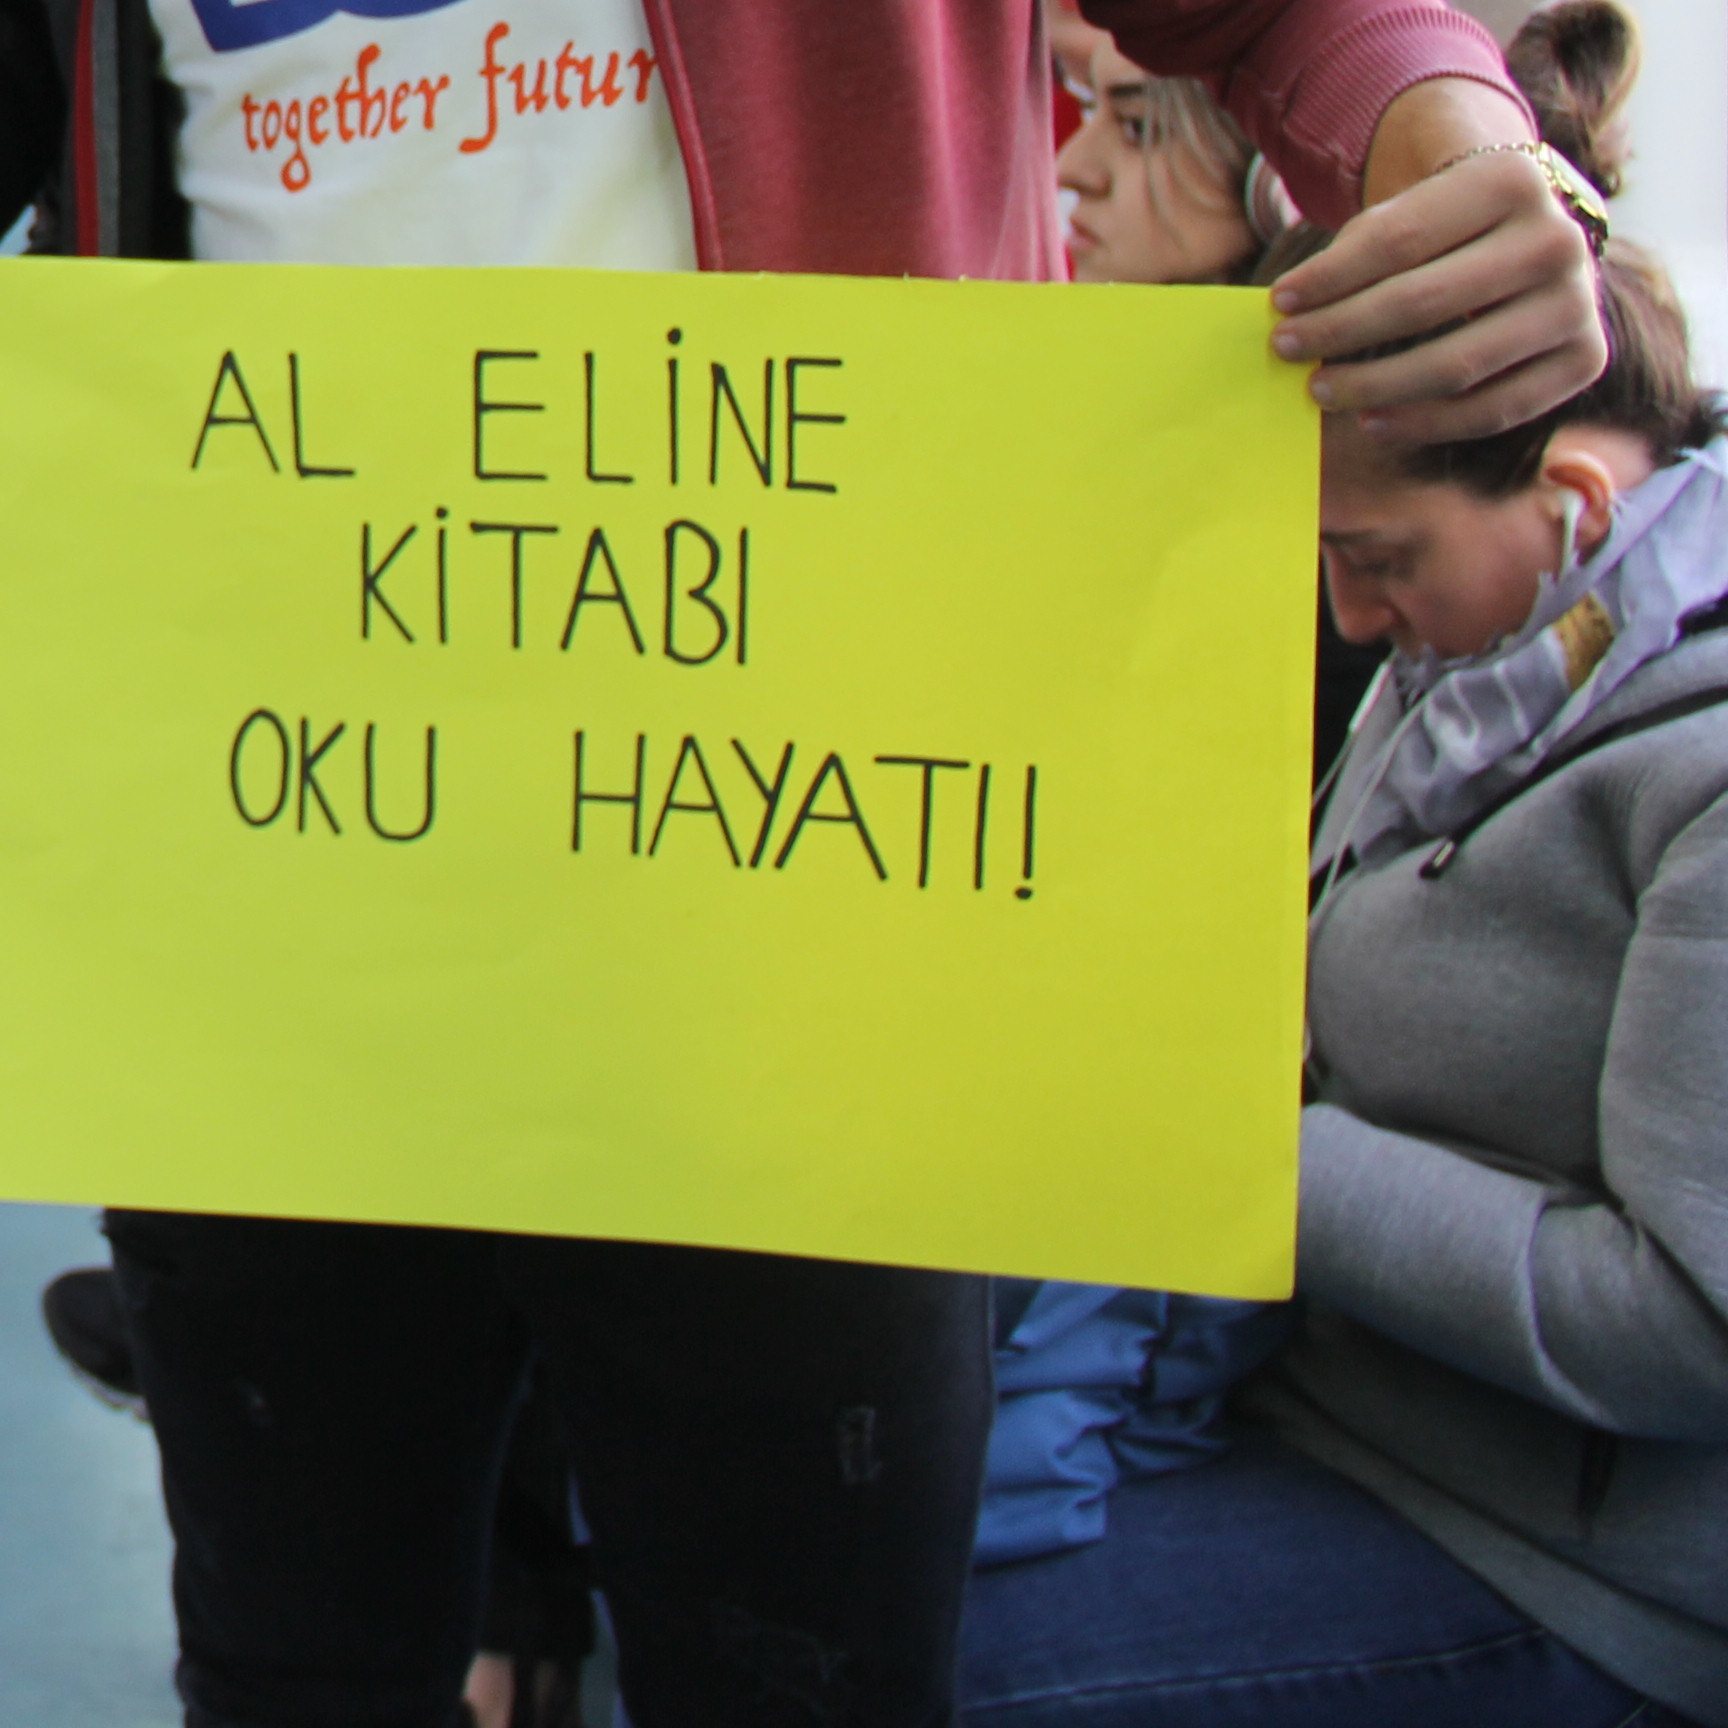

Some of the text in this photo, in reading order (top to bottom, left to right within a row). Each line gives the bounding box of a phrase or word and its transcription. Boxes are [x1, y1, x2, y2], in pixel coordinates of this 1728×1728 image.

[241, 43, 450, 194] together
[191, 327, 848, 495] AL ELİNE
[360, 506, 750, 668] KİTABI
[228, 707, 1039, 902] OKU HAYATI!
